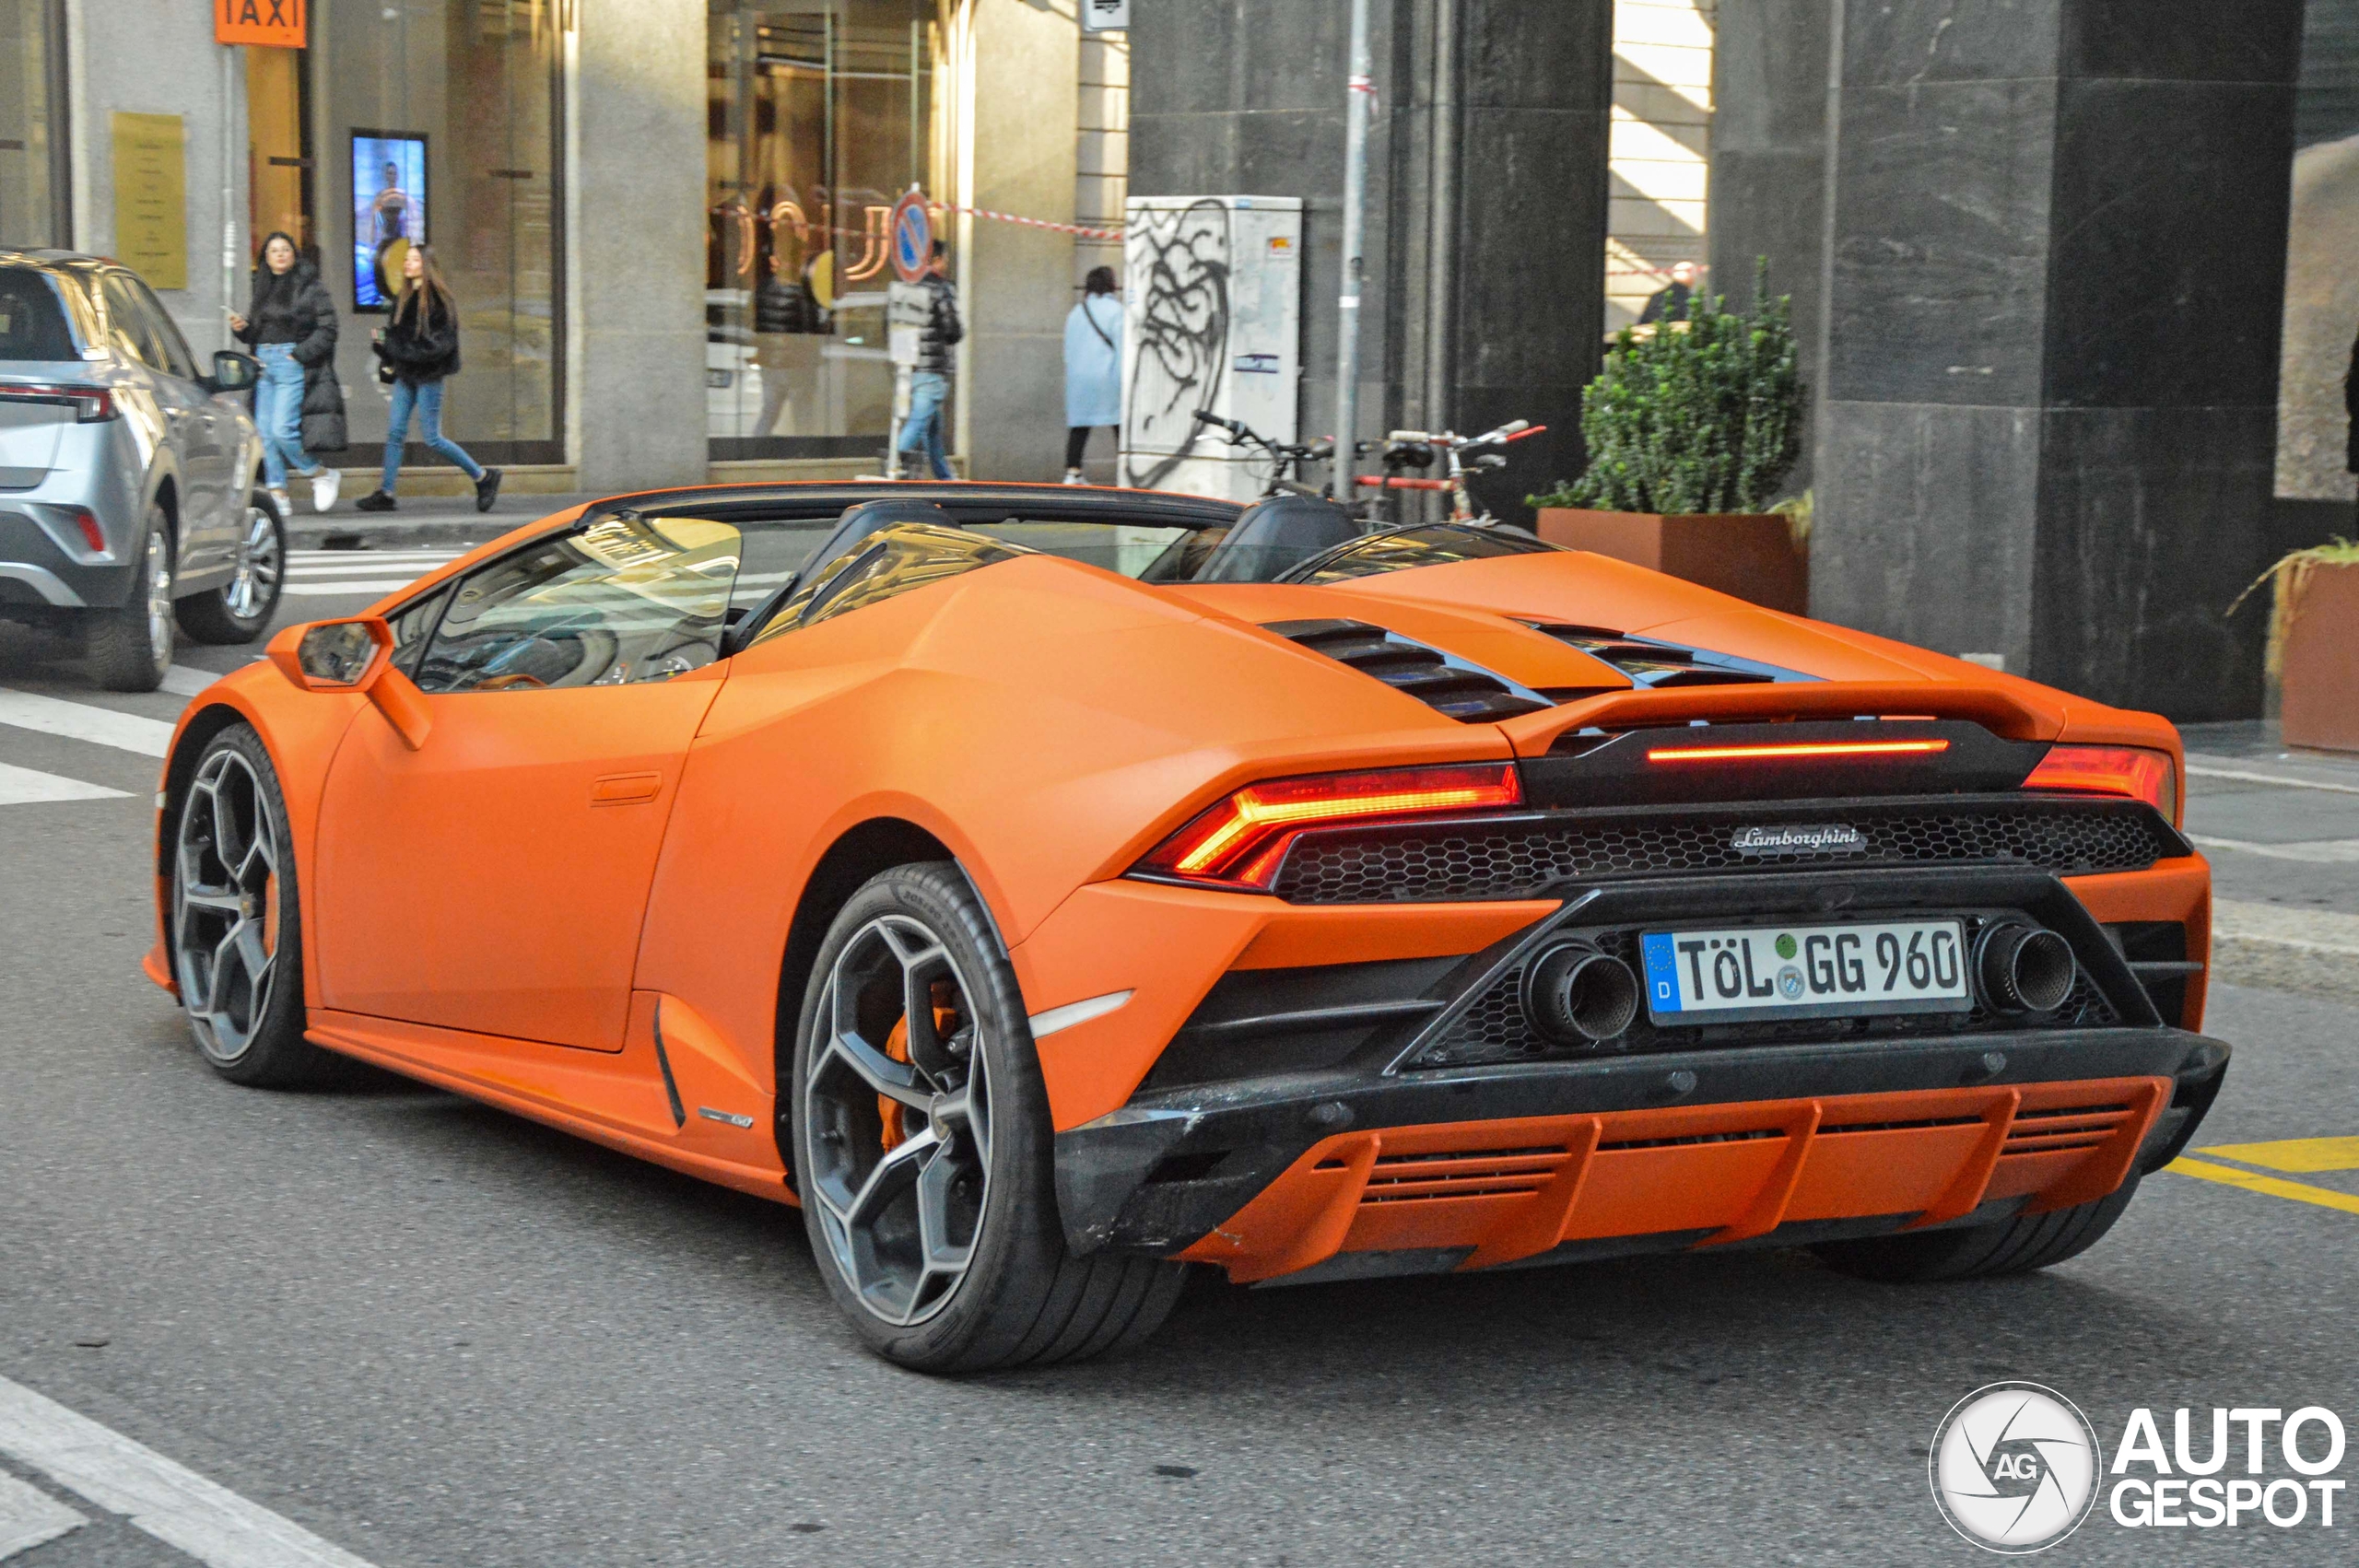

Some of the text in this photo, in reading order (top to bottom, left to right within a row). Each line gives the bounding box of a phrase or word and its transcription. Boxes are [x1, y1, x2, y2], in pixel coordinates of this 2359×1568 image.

[1734, 827, 1860, 848] Lamborghini
[1678, 938, 1774, 1001] TÖL
[1805, 933, 1867, 994] GG
[1876, 930, 1959, 991] 960
[1658, 981, 1671, 1000] D
